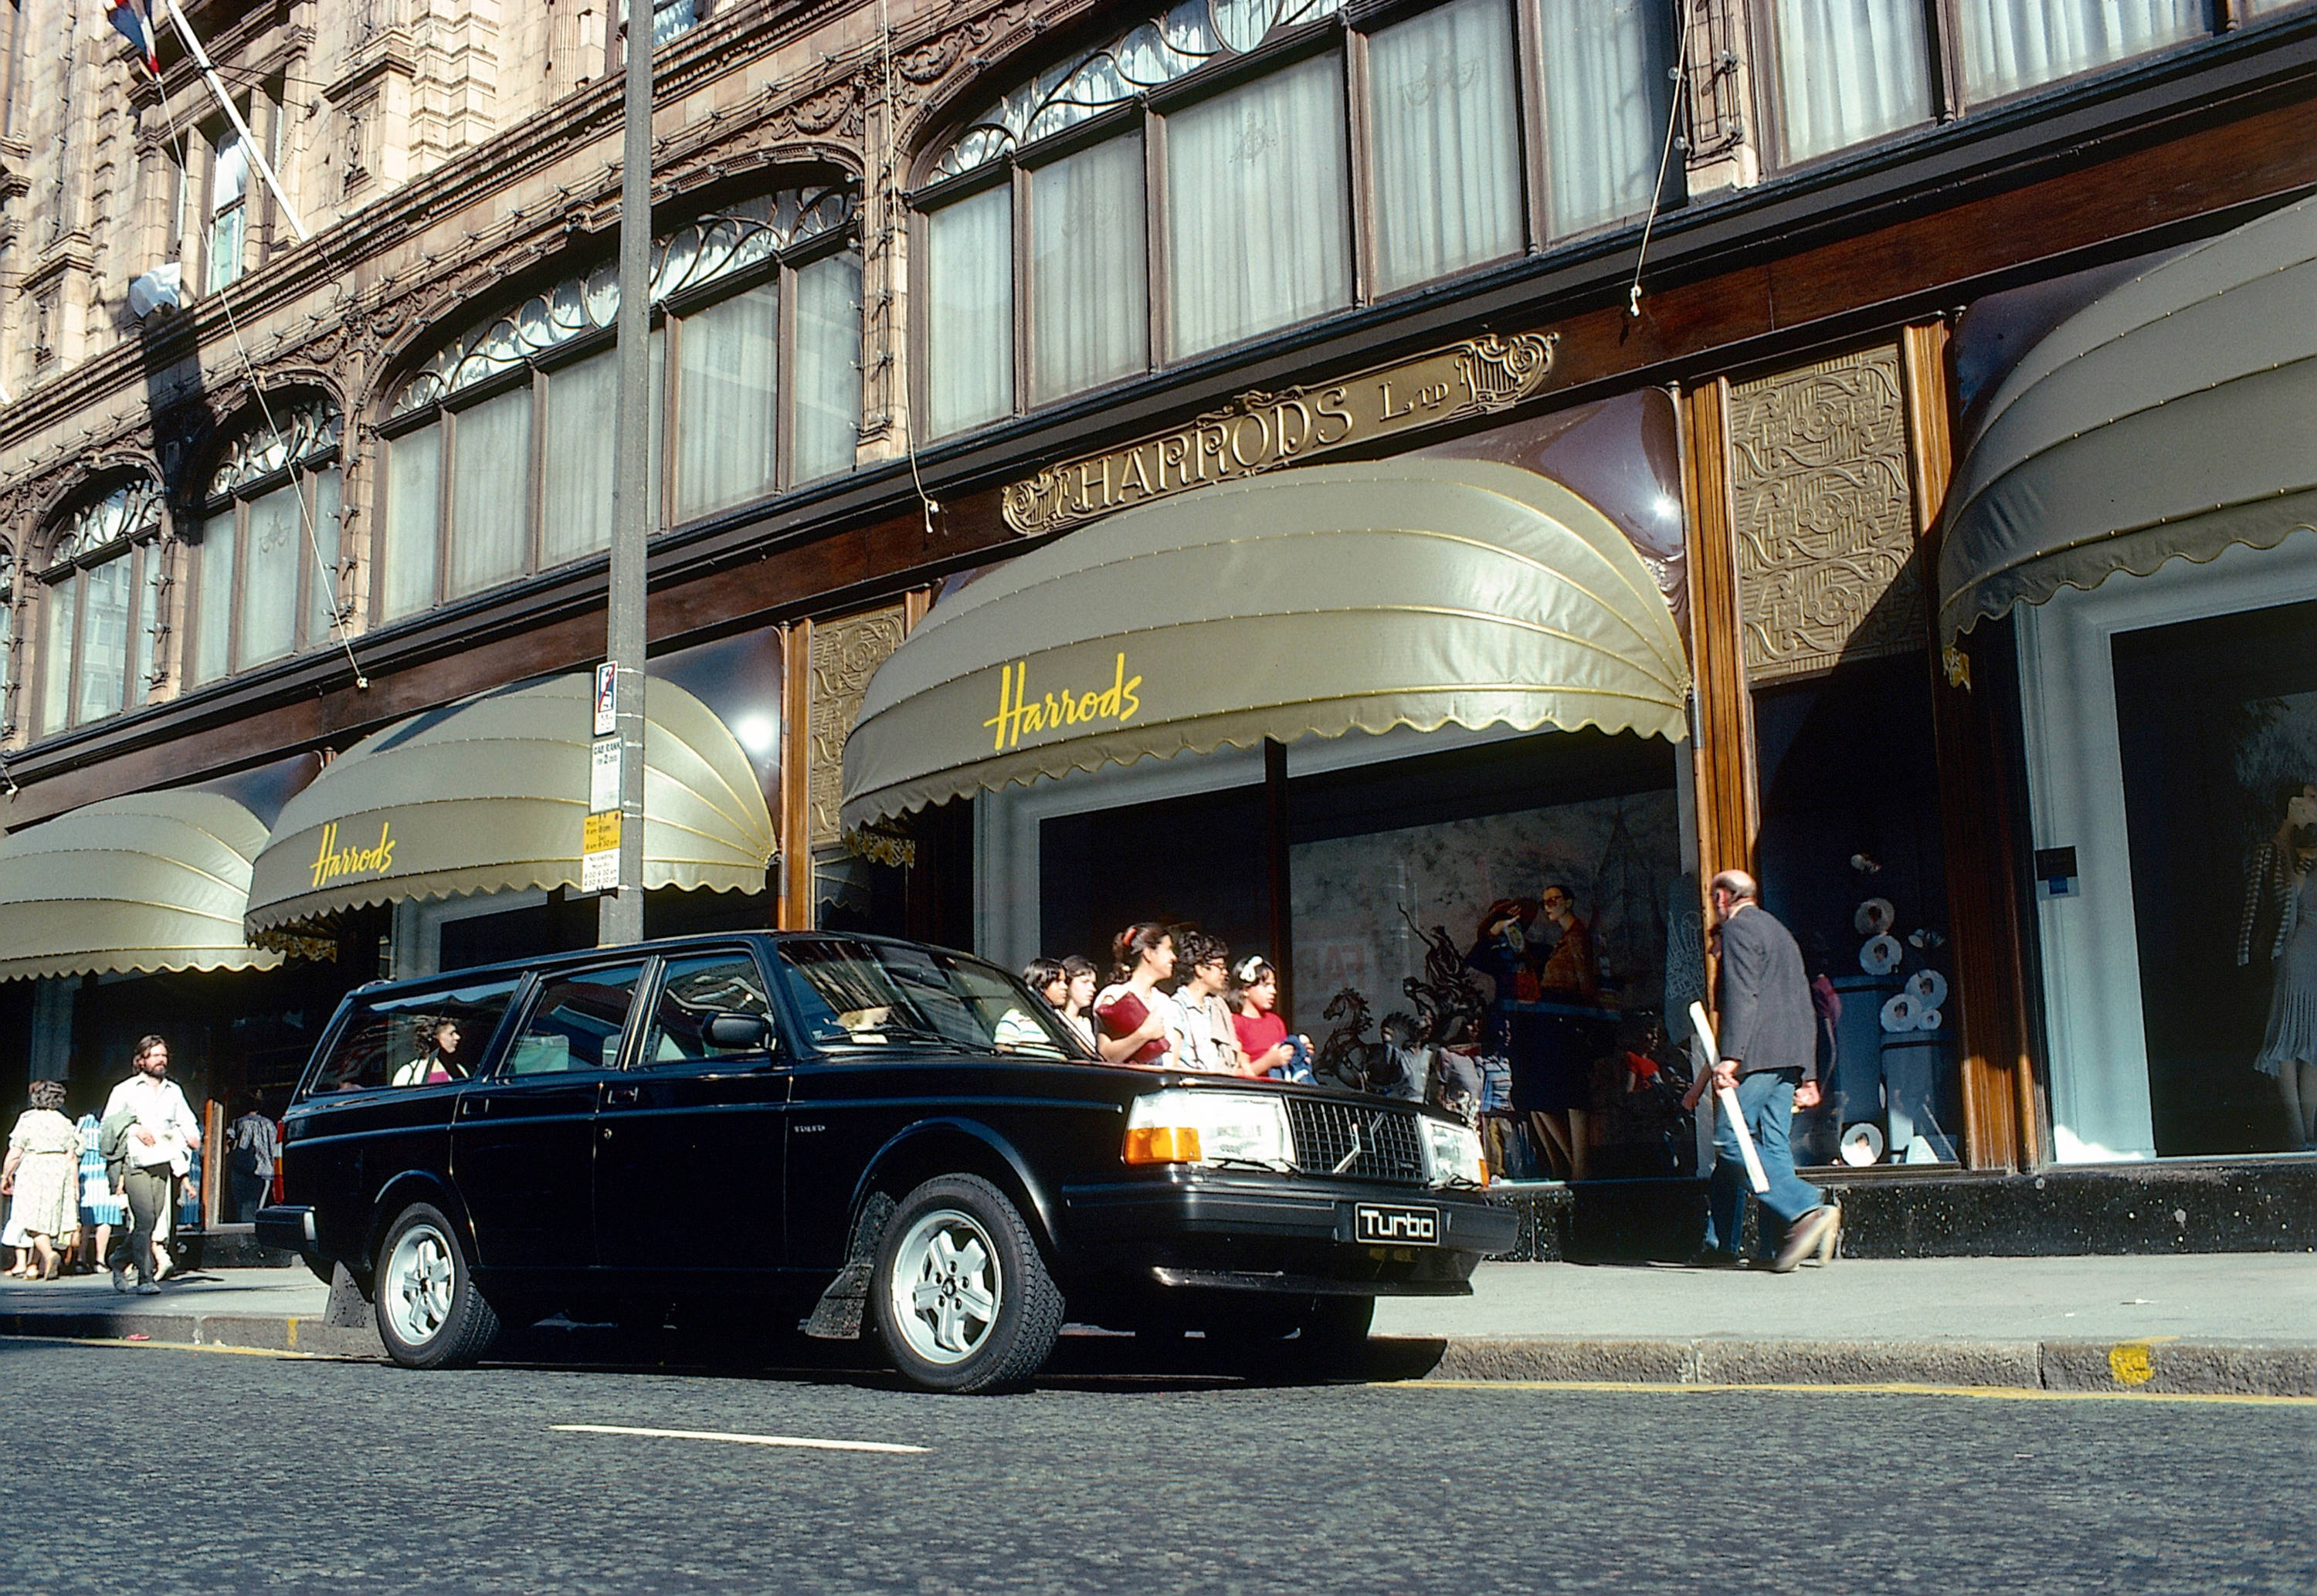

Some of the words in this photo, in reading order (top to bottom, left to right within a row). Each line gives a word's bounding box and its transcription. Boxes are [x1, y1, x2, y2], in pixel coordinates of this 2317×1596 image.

[1071, 386, 1353, 512] HARRODS
[983, 652, 1142, 751] Harrods
[310, 822, 396, 888] Harrods
[1360, 1209, 1434, 1239] Turbo
